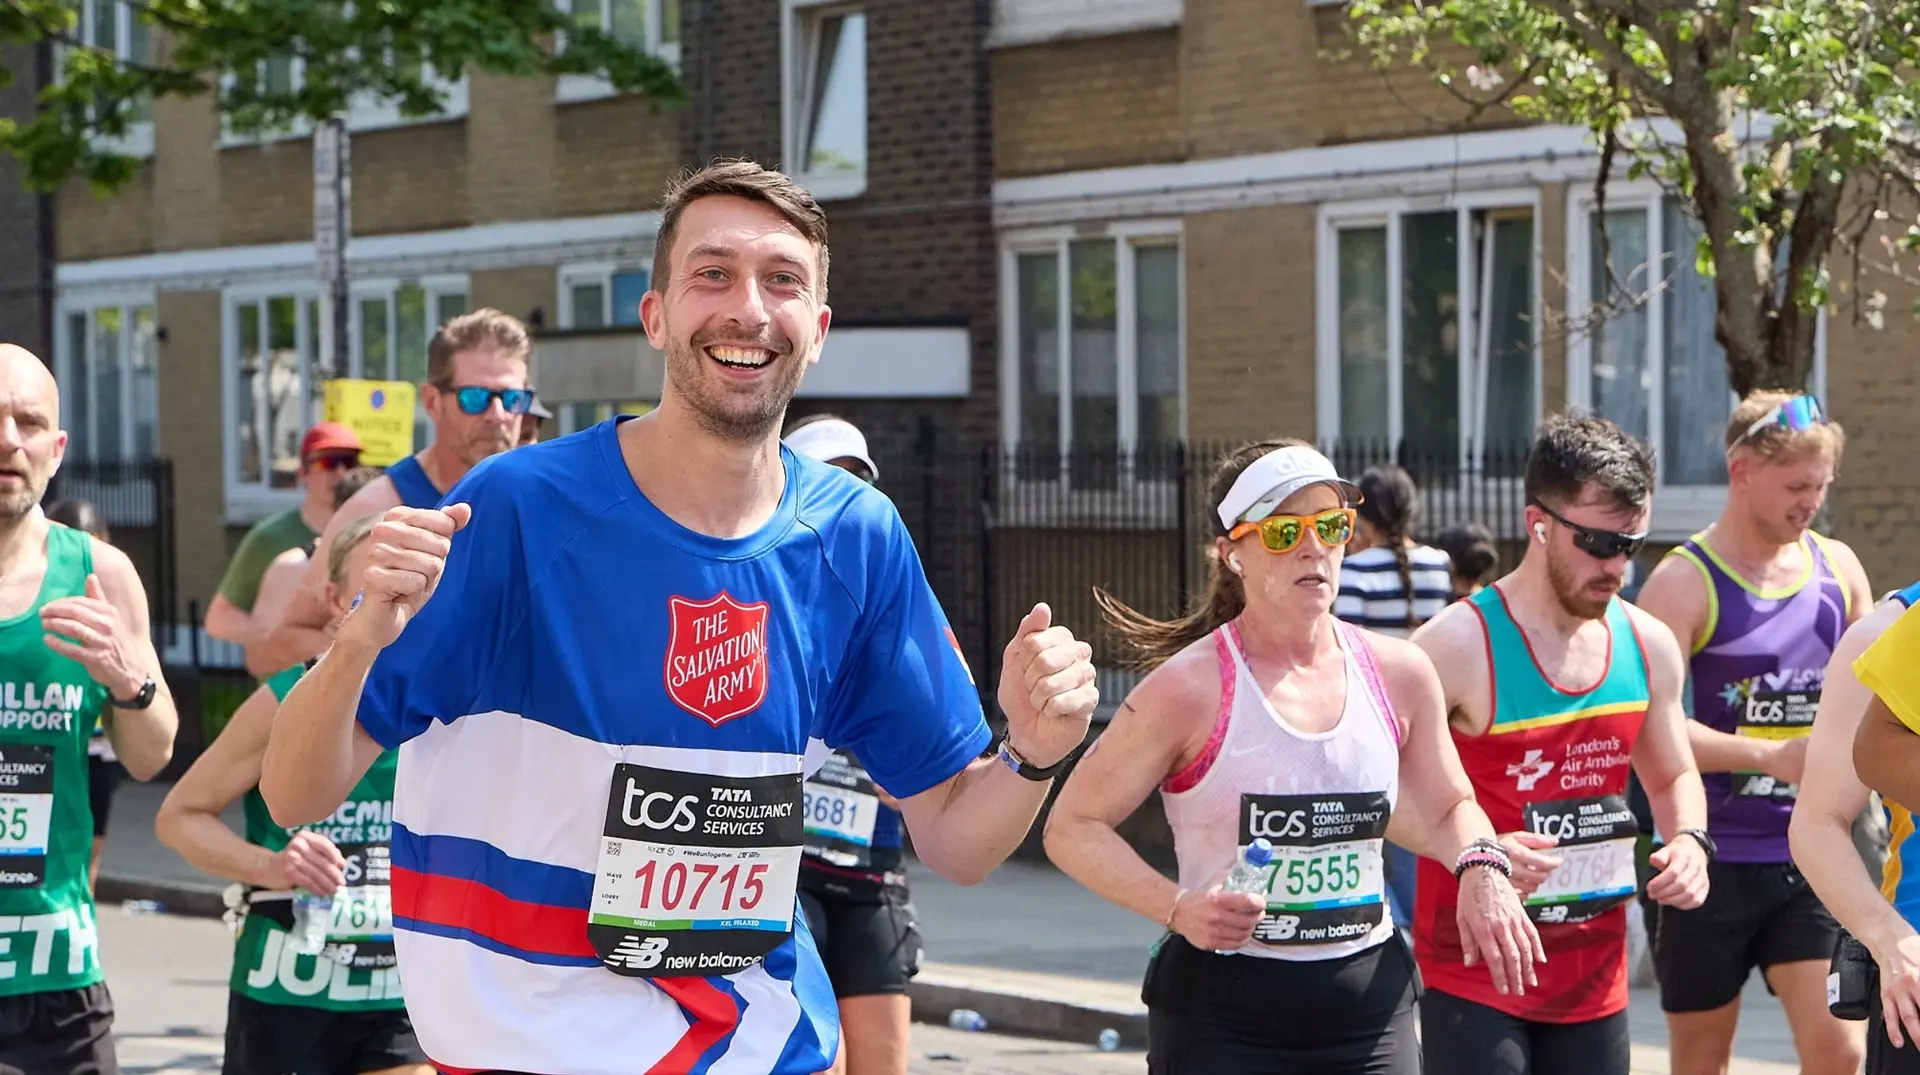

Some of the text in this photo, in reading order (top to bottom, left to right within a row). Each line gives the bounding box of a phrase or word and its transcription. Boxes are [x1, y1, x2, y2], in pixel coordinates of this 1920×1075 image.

[693, 610, 728, 644] THE
[672, 621, 760, 687] SALVATION
[704, 659, 759, 708] ARMY
[0, 682, 83, 711] LLAN
[1746, 694, 1784, 722] tcs
[1565, 735, 1620, 758] London's
[1560, 757, 1582, 773] Air
[1560, 772, 1607, 791] Charity
[711, 787, 752, 802] TATA
[622, 777, 699, 833] tcs
[706, 803, 793, 819] CONSULTANCY
[1312, 801, 1345, 813] TATA
[1578, 803, 1603, 816] TATA
[1250, 802, 1306, 838] tcs
[1312, 811, 1383, 826] CONSULTANCY
[1532, 810, 1576, 840] tcs
[702, 821, 765, 836] SERVICES
[1311, 824, 1355, 839] SERVICES
[683, 850, 733, 859] #WeRunTogether
[1266, 852, 1360, 896] 75555
[635, 859, 769, 912] 10715
[333, 897, 392, 929] 761
[632, 919, 657, 928] MEDAL
[719, 919, 760, 928] XXL RELAXED
[1299, 927, 1327, 940] new
[1327, 921, 1373, 938] balance
[247, 928, 406, 1000] JULI
[665, 957, 697, 969] new
[698, 951, 761, 969] balance
